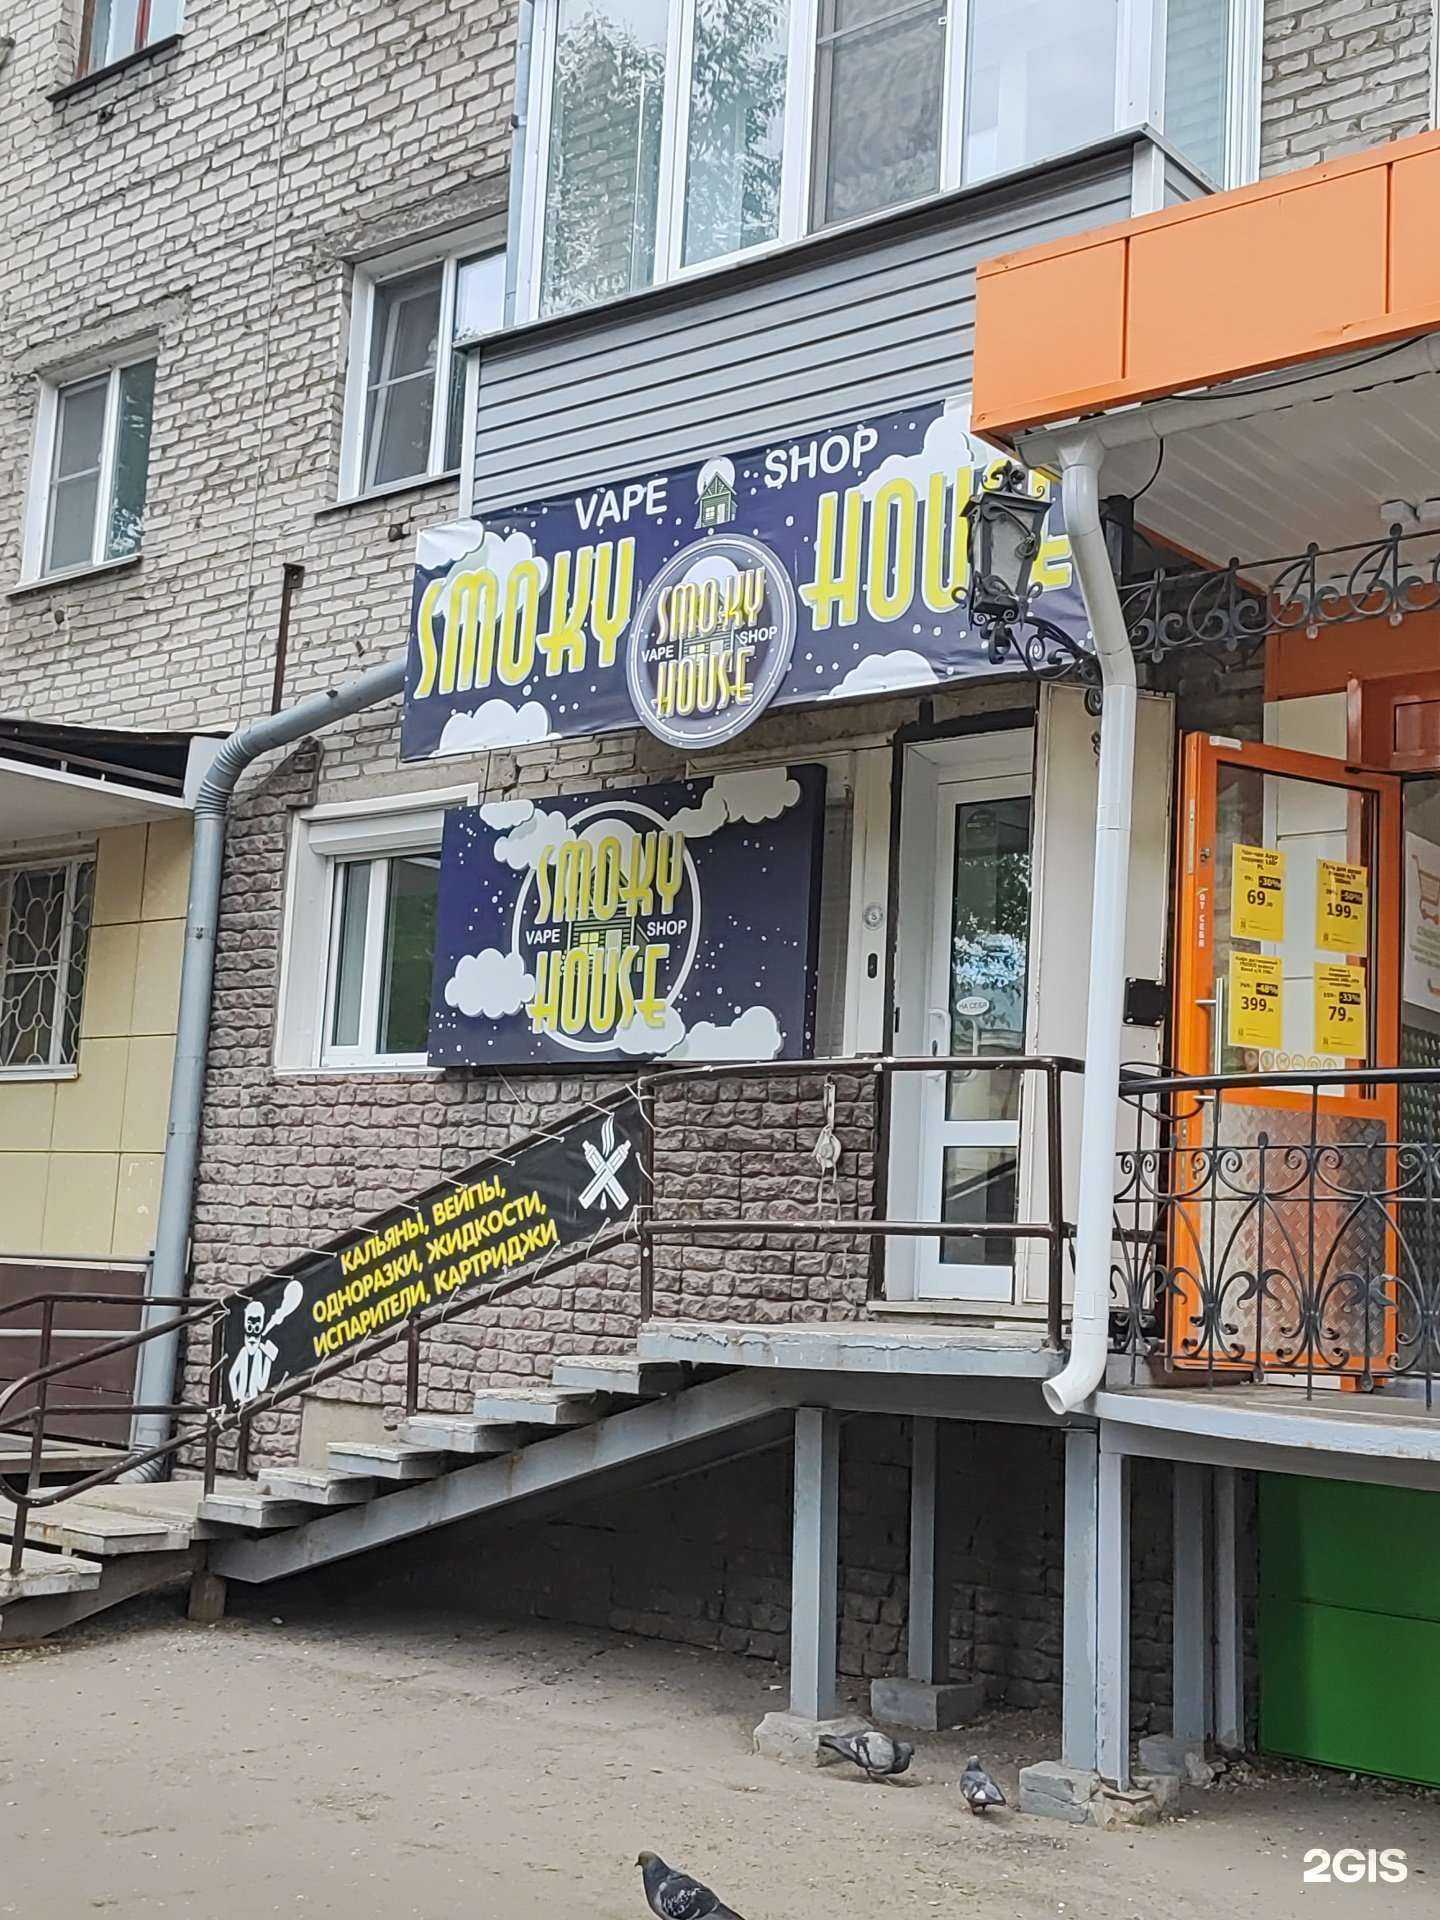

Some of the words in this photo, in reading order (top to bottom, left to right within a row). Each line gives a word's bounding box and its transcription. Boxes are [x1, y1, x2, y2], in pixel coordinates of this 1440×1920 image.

[575, 476, 668, 530] VAPE
[764, 426, 879, 489] SHOP
[413, 536, 636, 699] SMOKY
[641, 645, 675, 663] VAPE
[739, 626, 778, 645] SHOP
[656, 566, 766, 645] SMOKY
[651, 645, 756, 719] HOUSE
[534, 830, 686, 925] SMOKY
[525, 929, 561, 945] VAPE
[646, 919, 688, 937] SHOP
[526, 944, 670, 1034] HOUSE
[312, 1250, 424, 1324] ОДНОРАЗКИ,
[427, 1190, 547, 1263] ЖИДКОСТИ,
[339, 1211, 430, 1275] КАЛЬЯНЫ,
[432, 1174, 506, 1223] ВЕЙПЫ,
[313, 1286, 431, 1358] ИСПАРИТЕЛИ,
[434, 1218, 560, 1295] КАРТРИДЖИ
